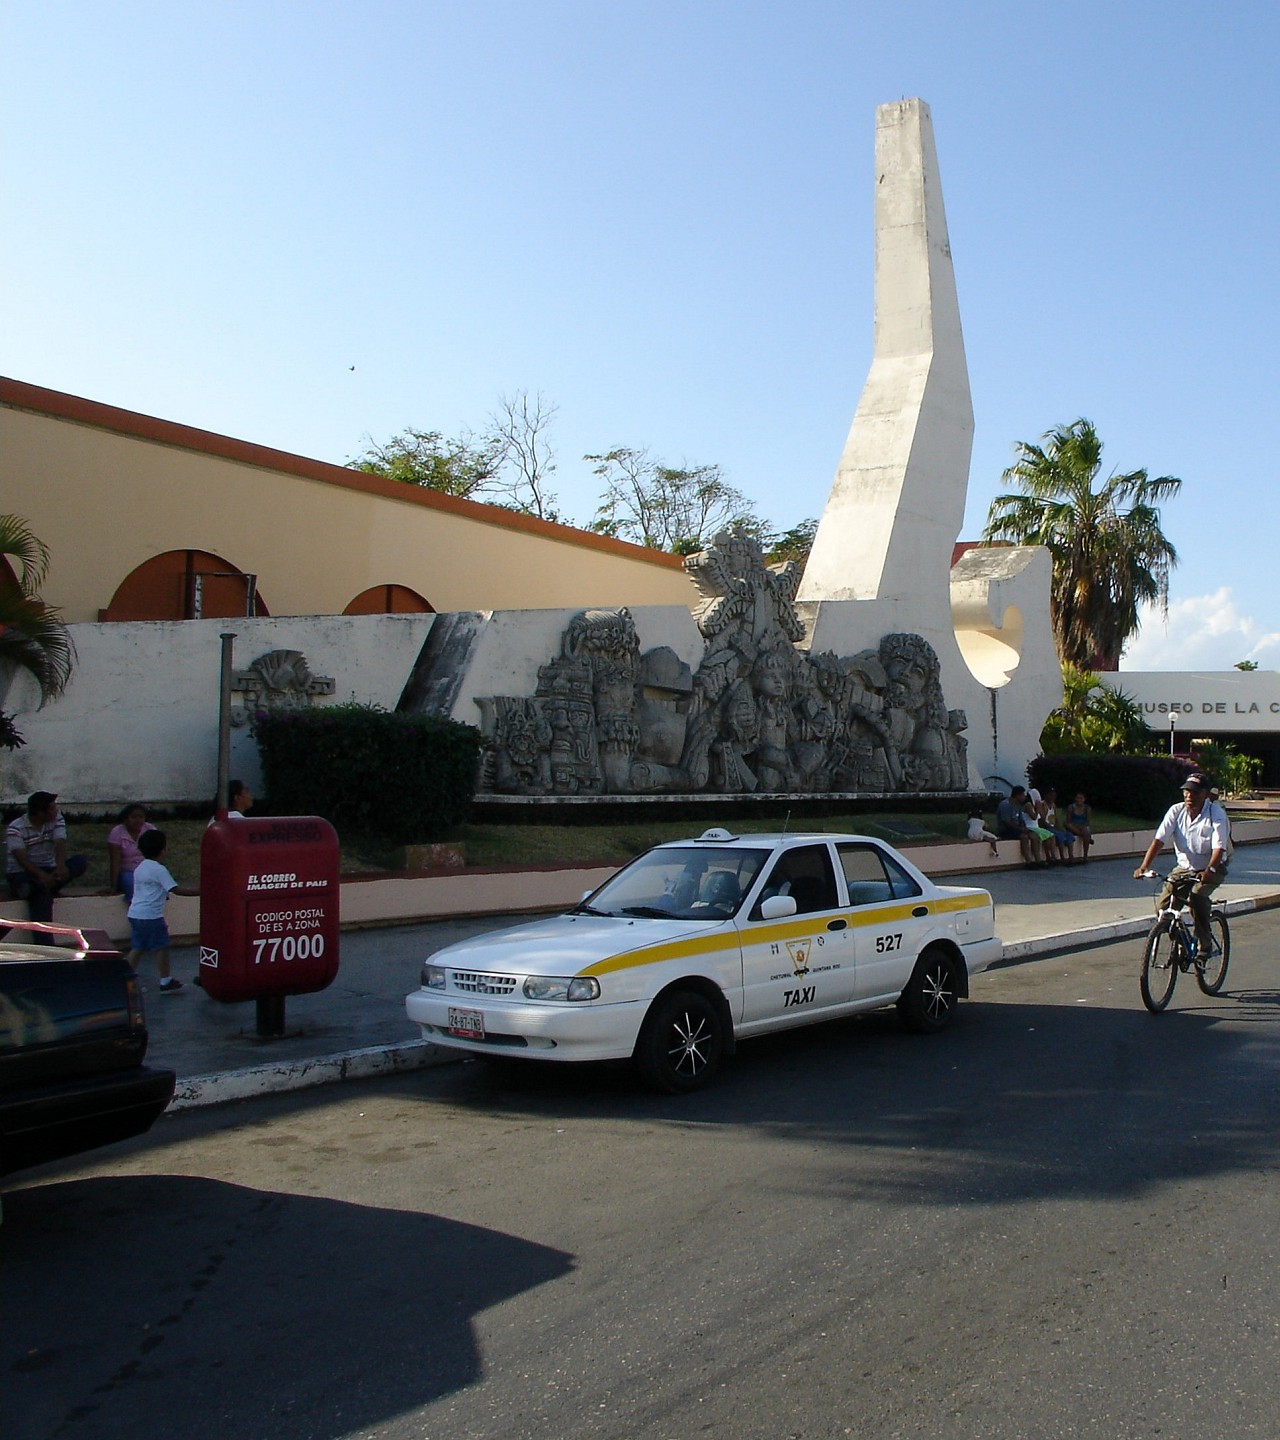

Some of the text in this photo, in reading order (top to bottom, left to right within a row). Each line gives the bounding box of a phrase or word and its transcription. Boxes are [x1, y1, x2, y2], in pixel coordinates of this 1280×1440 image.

[1202, 702, 1227, 714] DE
[1234, 702, 1260, 714] LA
[247, 831, 322, 844] EXPRESSO
[248, 873, 297, 884] EL CORREO
[247, 882, 288, 891] IMAGEN
[255, 908, 325, 923] CODIGO POSTAL
[259, 923, 271, 933] DE
[294, 919, 321, 930] ZONA
[252, 933, 325, 964] 77000
[875, 933, 903, 954] 527
[783, 985, 816, 1008] TAXI
